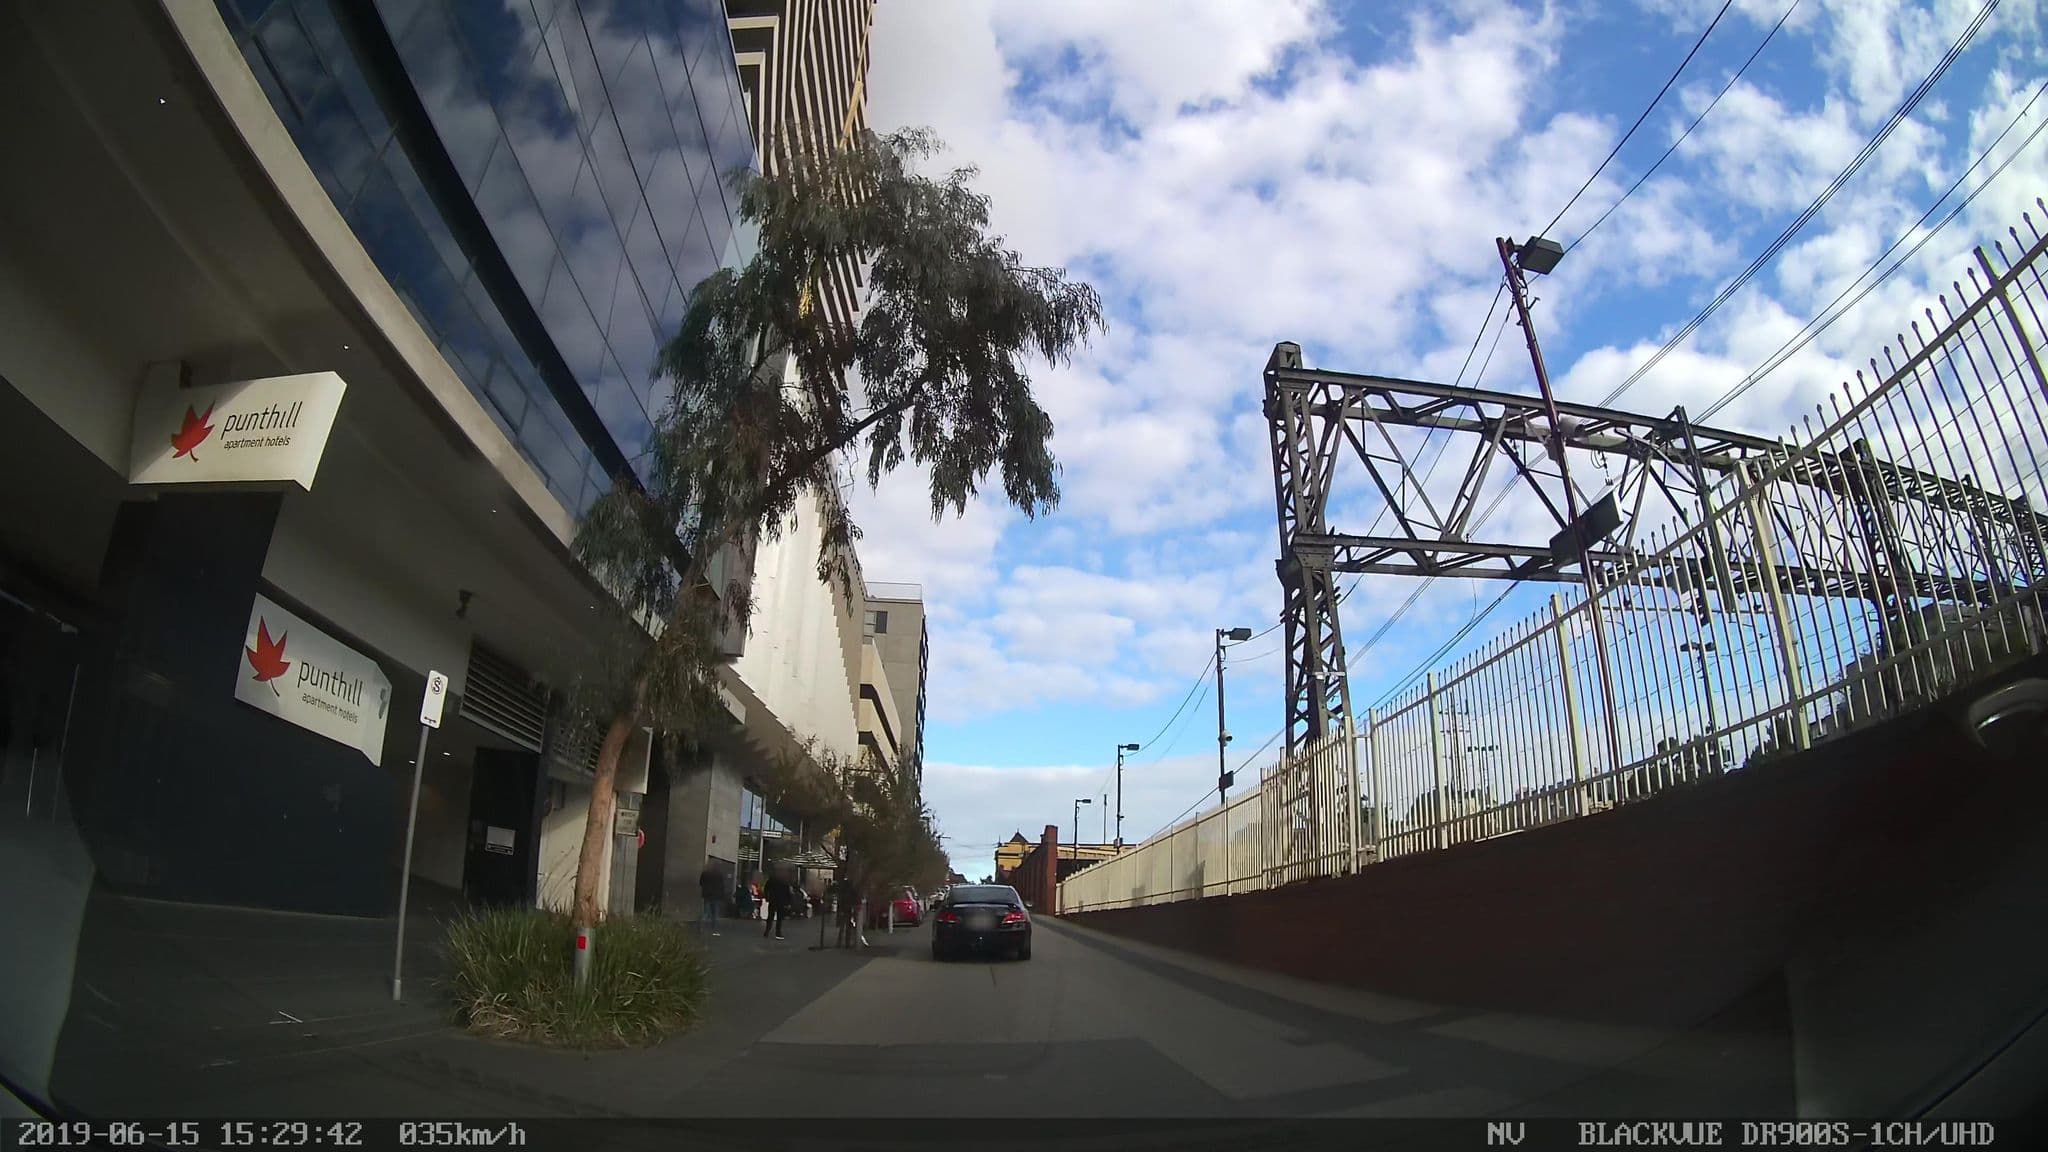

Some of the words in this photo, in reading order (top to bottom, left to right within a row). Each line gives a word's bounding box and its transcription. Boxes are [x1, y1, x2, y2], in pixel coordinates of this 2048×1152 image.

[221, 401, 303, 440] punthill
[224, 438, 264, 451] apartment
[265, 435, 291, 448] hotels
[297, 661, 363, 706] punthill
[302, 693, 338, 715] apartment
[339, 706, 359, 724] hotels
